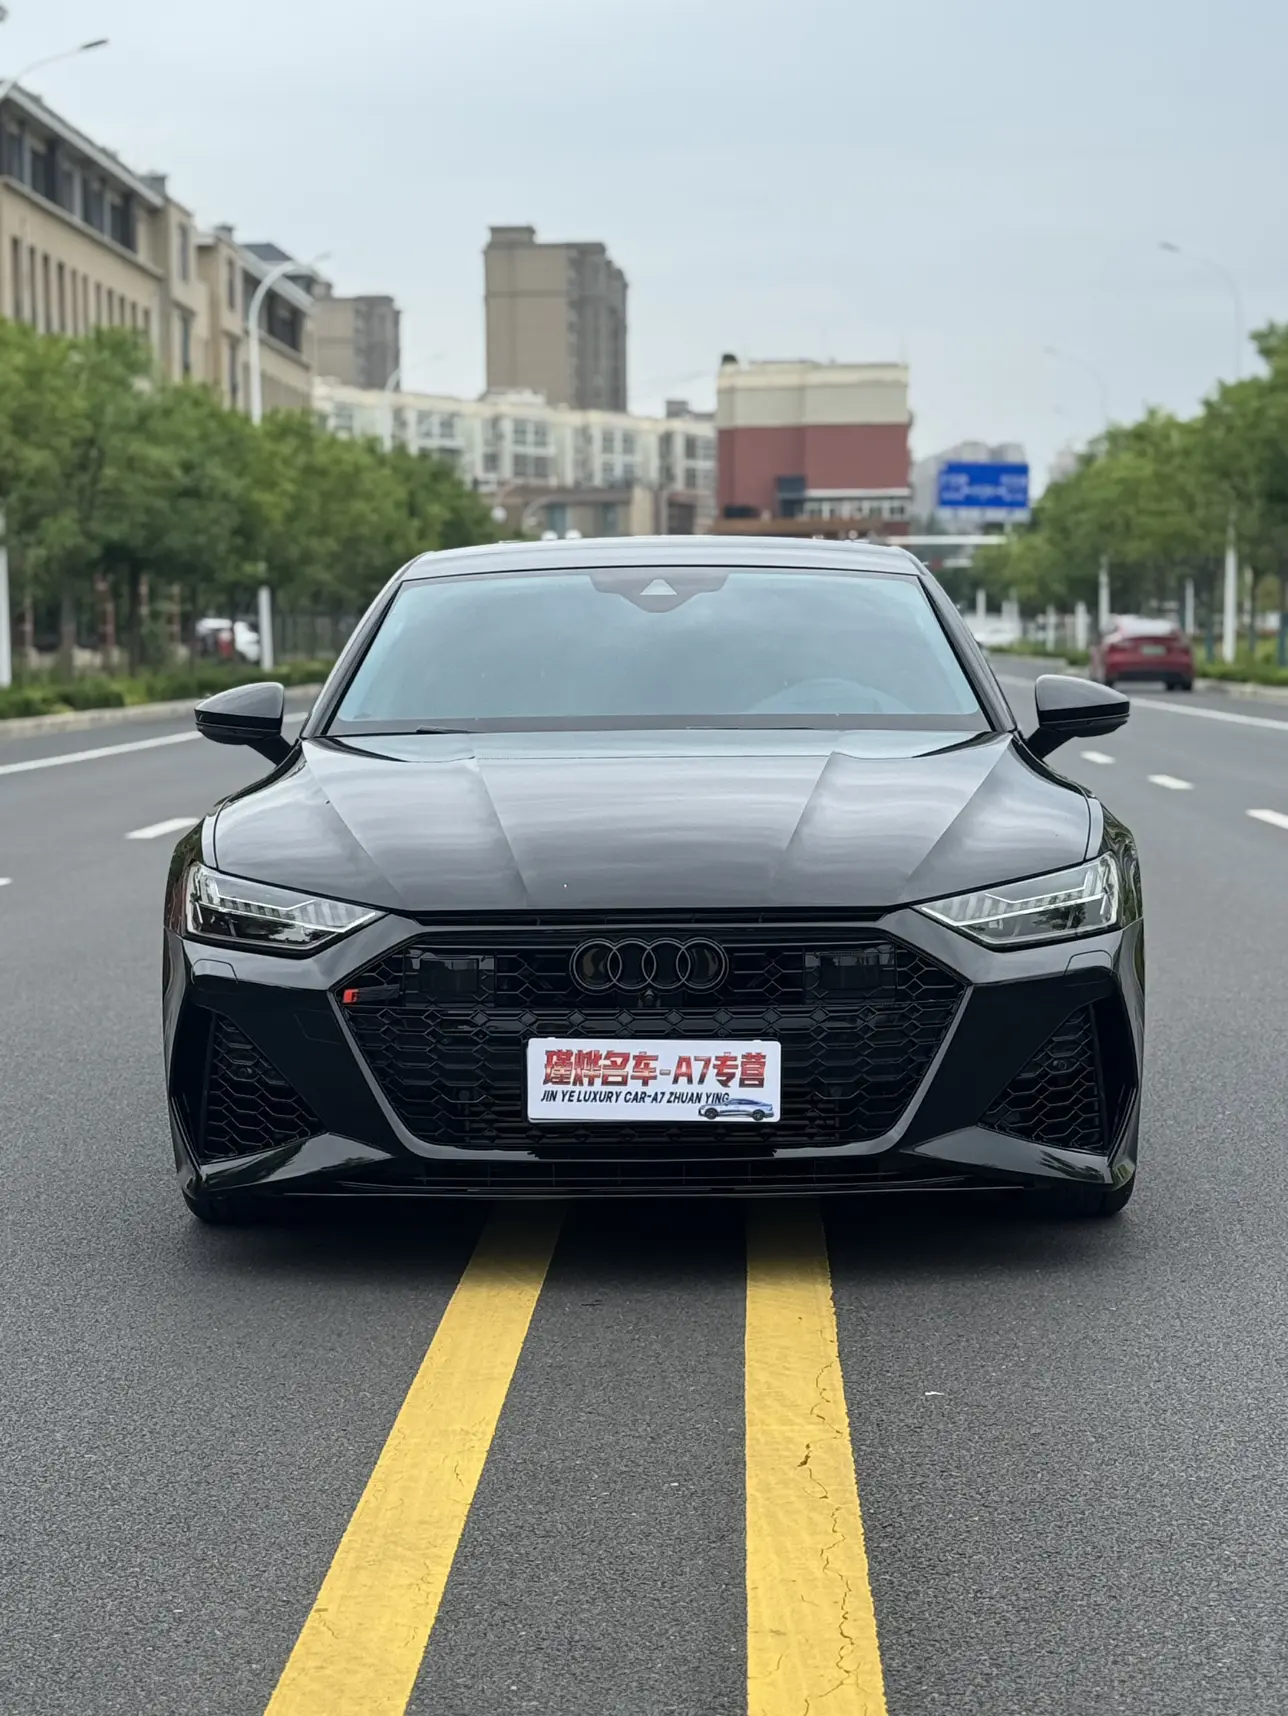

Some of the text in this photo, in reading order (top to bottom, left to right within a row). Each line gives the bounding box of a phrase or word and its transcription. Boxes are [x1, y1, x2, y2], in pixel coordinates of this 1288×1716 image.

[540, 1090, 730, 1105] JIN YE LUXURY CAR-A7 ZHUAN YING
